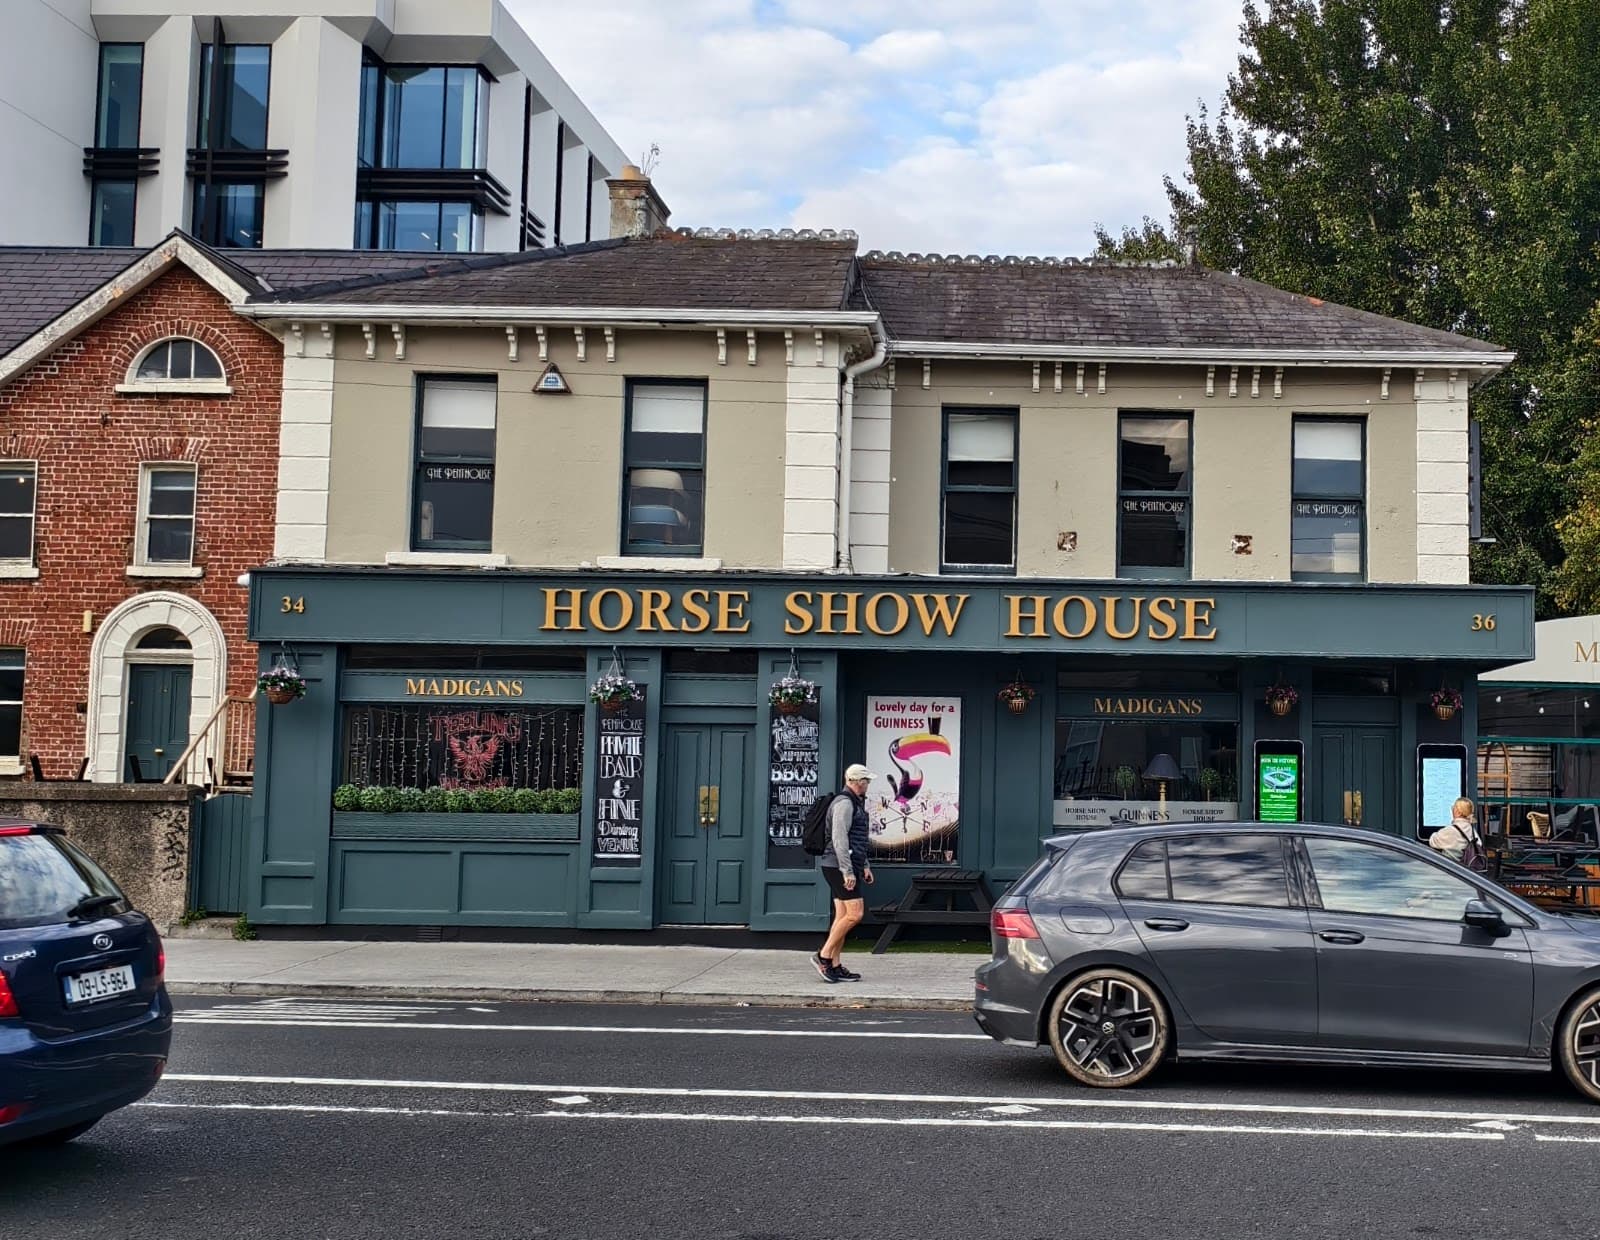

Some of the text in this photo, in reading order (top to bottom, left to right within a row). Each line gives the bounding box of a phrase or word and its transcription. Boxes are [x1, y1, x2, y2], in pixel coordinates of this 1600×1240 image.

[427, 467, 442, 479] THE
[1124, 500, 1138, 512] THE
[280, 595, 305, 613] 34
[539, 587, 1217, 640] HORSE SHOW HOUSE
[1471, 613, 1497, 631] 36
[404, 678, 523, 697] MADIGANS
[875, 701, 955, 714] Lovely day for a
[1093, 697, 1203, 715] MADIGANS
[601, 718, 643, 731] PENTHOUSE
[874, 716, 925, 729] GUINNESS
[600, 736, 643, 756] PRIVATE
[600, 755, 642, 778] BAR
[612, 779, 630, 799] &
[598, 799, 640, 820] FINE
[1119, 808, 1170, 821] GUINNESS
[597, 837, 639, 853] VENUE
